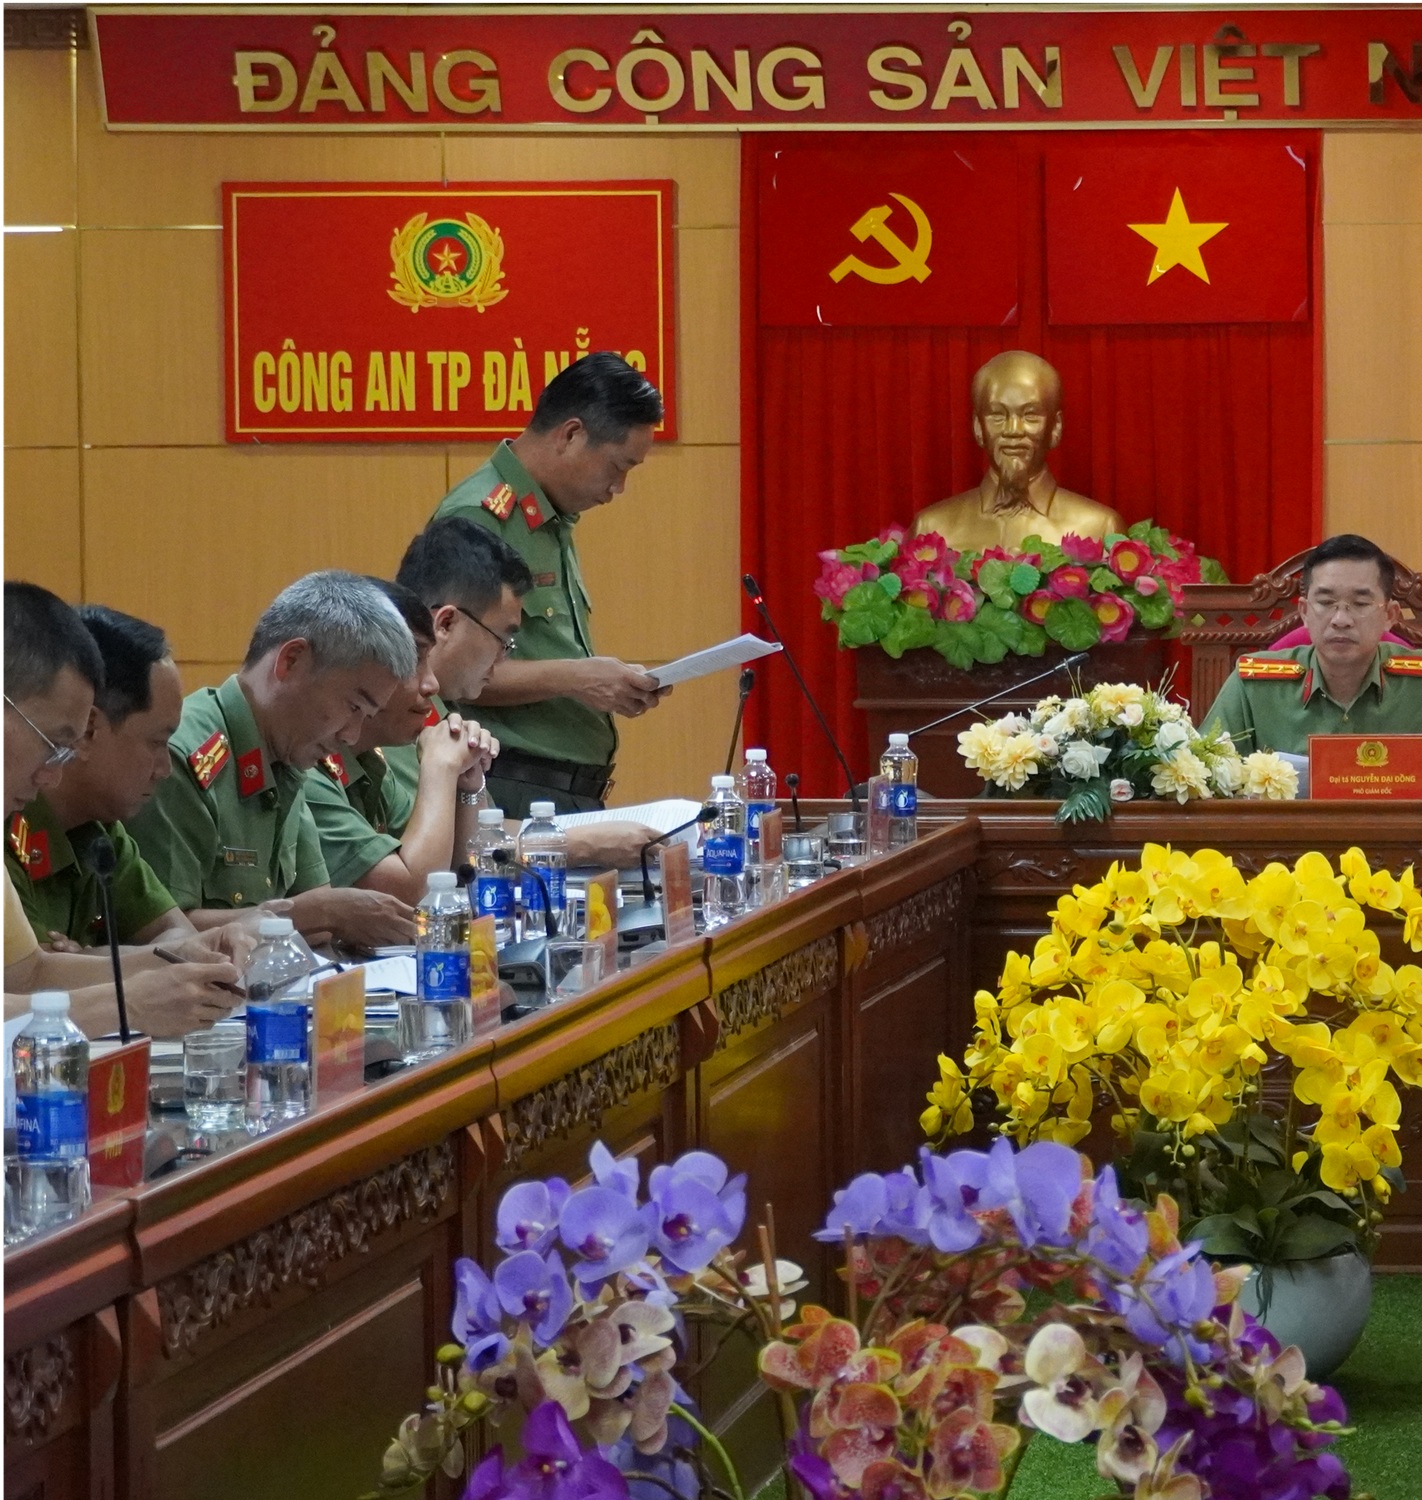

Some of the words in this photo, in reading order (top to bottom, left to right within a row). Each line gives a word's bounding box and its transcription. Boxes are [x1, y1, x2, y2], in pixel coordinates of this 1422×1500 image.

[233, 24, 502, 114] ĐẢNG
[547, 29, 826, 125] CỘNG
[866, 20, 1063, 111] SẢN
[1111, 22, 1320, 121] VIỆT
[253, 338, 353, 413] CÔNG
[365, 351, 416, 411] AN
[427, 351, 470, 411] TP
[483, 337, 533, 411] ĐÀ
